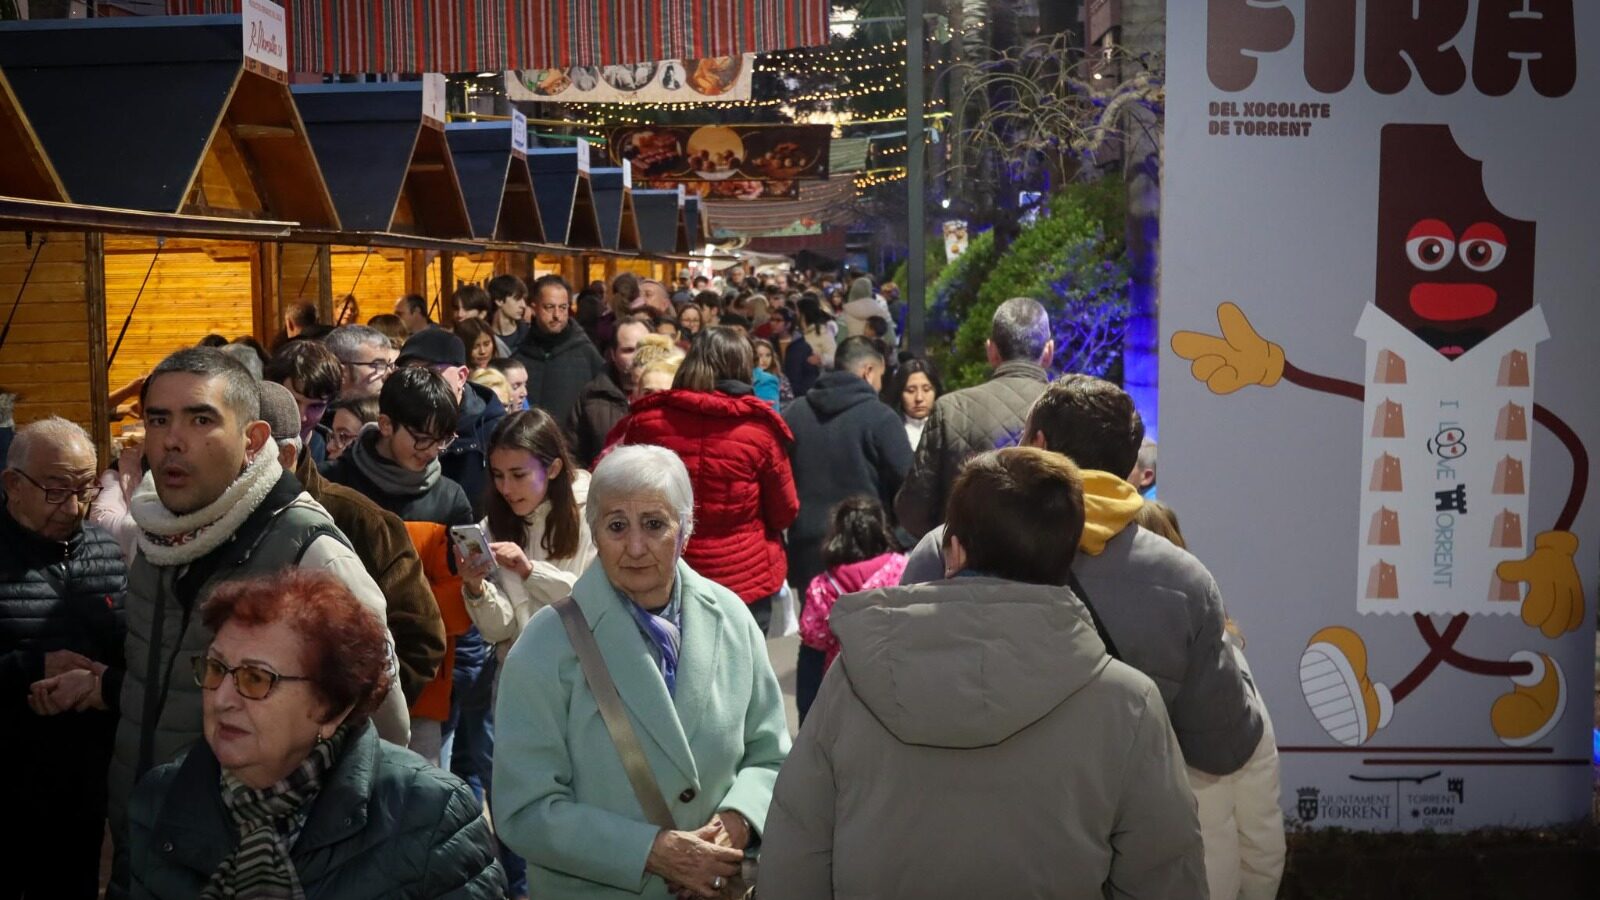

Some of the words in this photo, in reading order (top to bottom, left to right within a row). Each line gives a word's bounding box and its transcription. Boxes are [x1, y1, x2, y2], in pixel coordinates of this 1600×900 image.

[1207, 0, 1577, 97] FIRA
[1208, 102, 1239, 117] DEL
[1243, 102, 1330, 118] XOCOLATE
[1208, 120, 1230, 135] DE
[1233, 120, 1312, 137] TORRENT
[1321, 795, 1391, 806] AJUNTAMENT
[1408, 795, 1456, 804] TORRENT
[1322, 806, 1391, 818] TORRENT
[1425, 807, 1454, 815] GRAN
